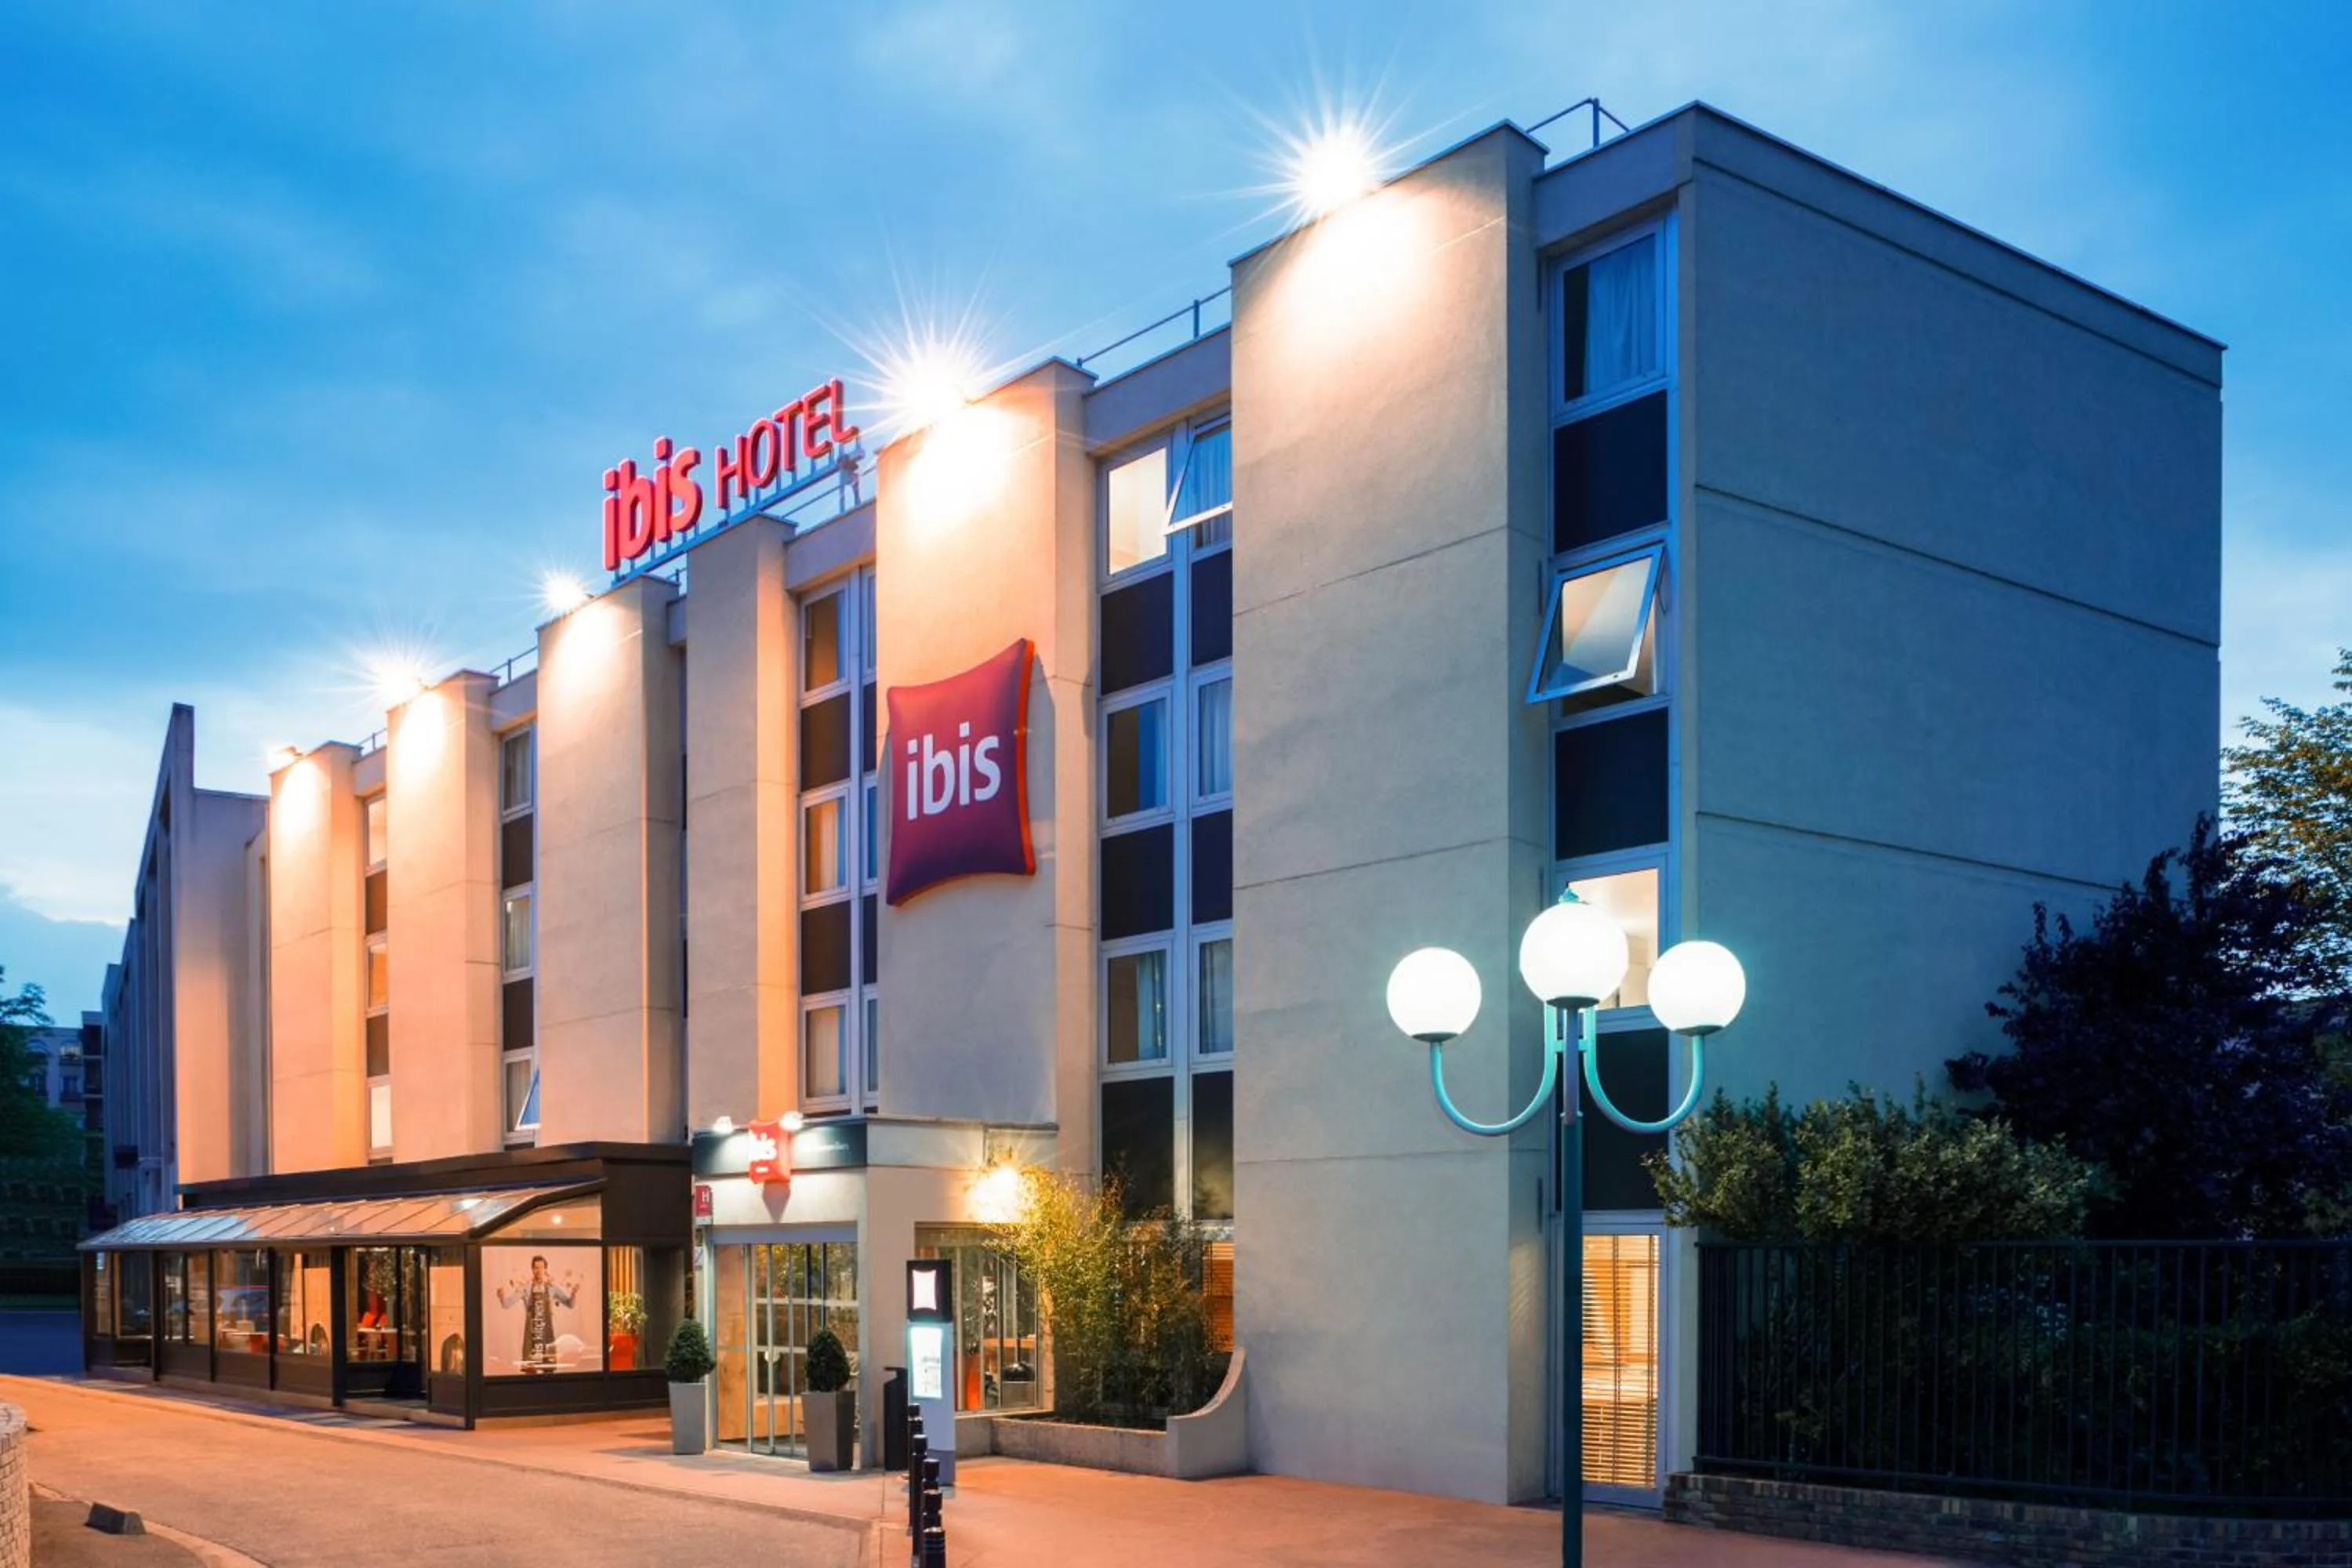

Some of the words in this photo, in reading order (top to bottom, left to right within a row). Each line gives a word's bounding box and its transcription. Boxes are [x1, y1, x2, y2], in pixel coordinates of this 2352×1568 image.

[603, 436, 702, 571] ibis
[715, 377, 860, 510] HOTEL
[907, 721, 1001, 821] ibis
